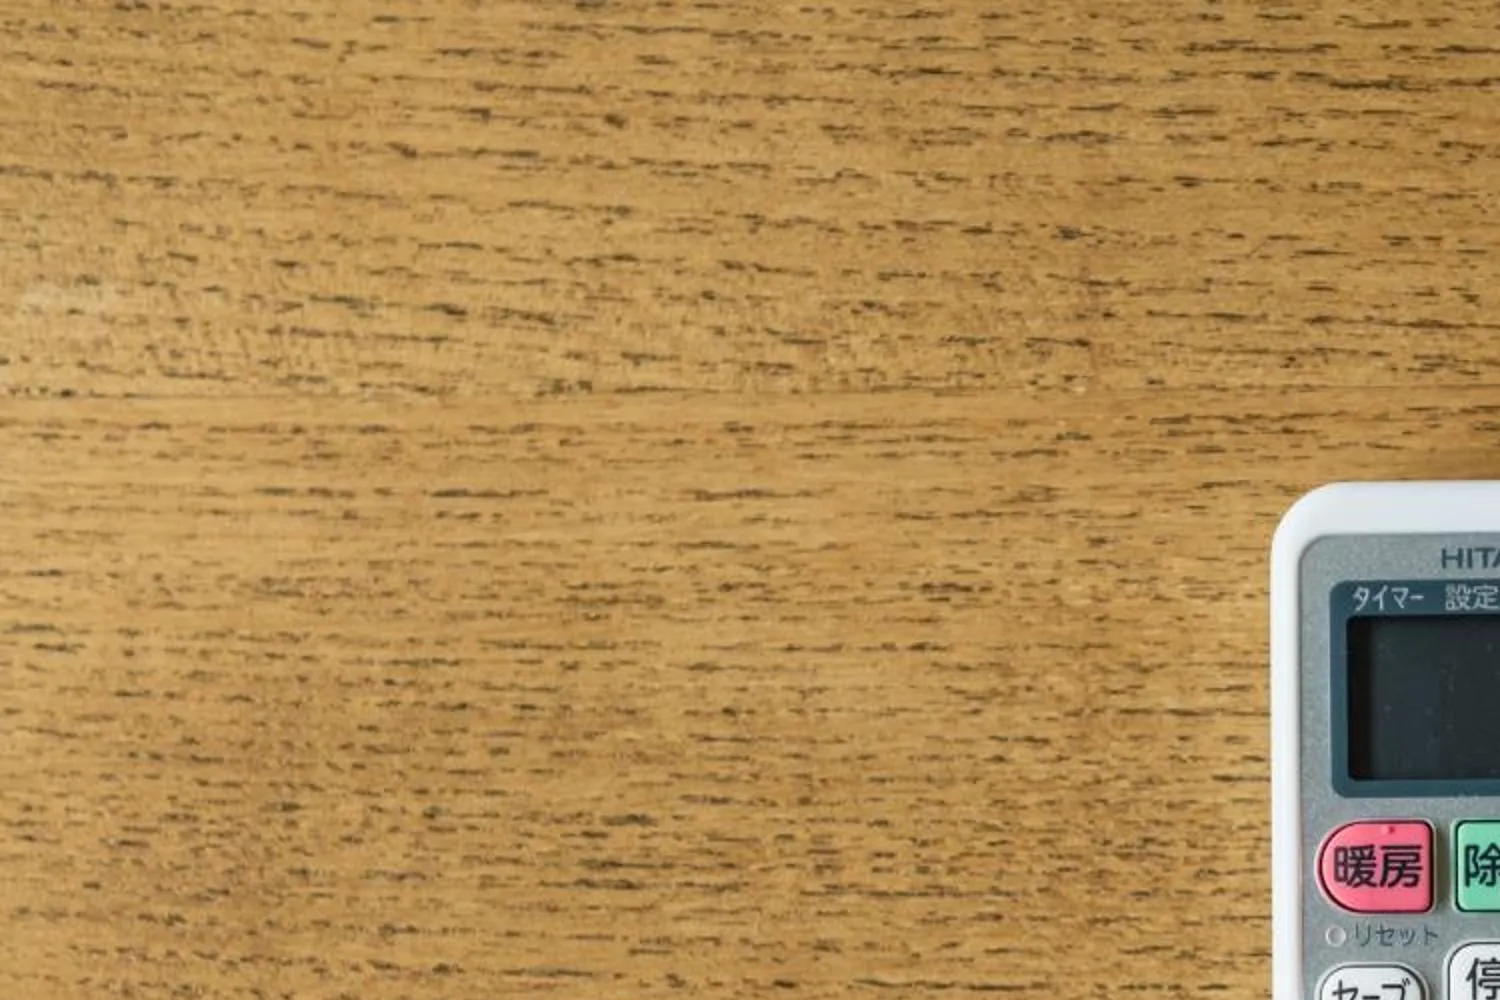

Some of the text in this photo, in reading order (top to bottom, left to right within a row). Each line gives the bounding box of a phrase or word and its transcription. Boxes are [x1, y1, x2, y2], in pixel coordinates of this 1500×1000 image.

[1352, 585, 1425, 611] タイマー
[1333, 844, 1424, 888] 暖房
[1354, 925, 1439, 947] リセット
